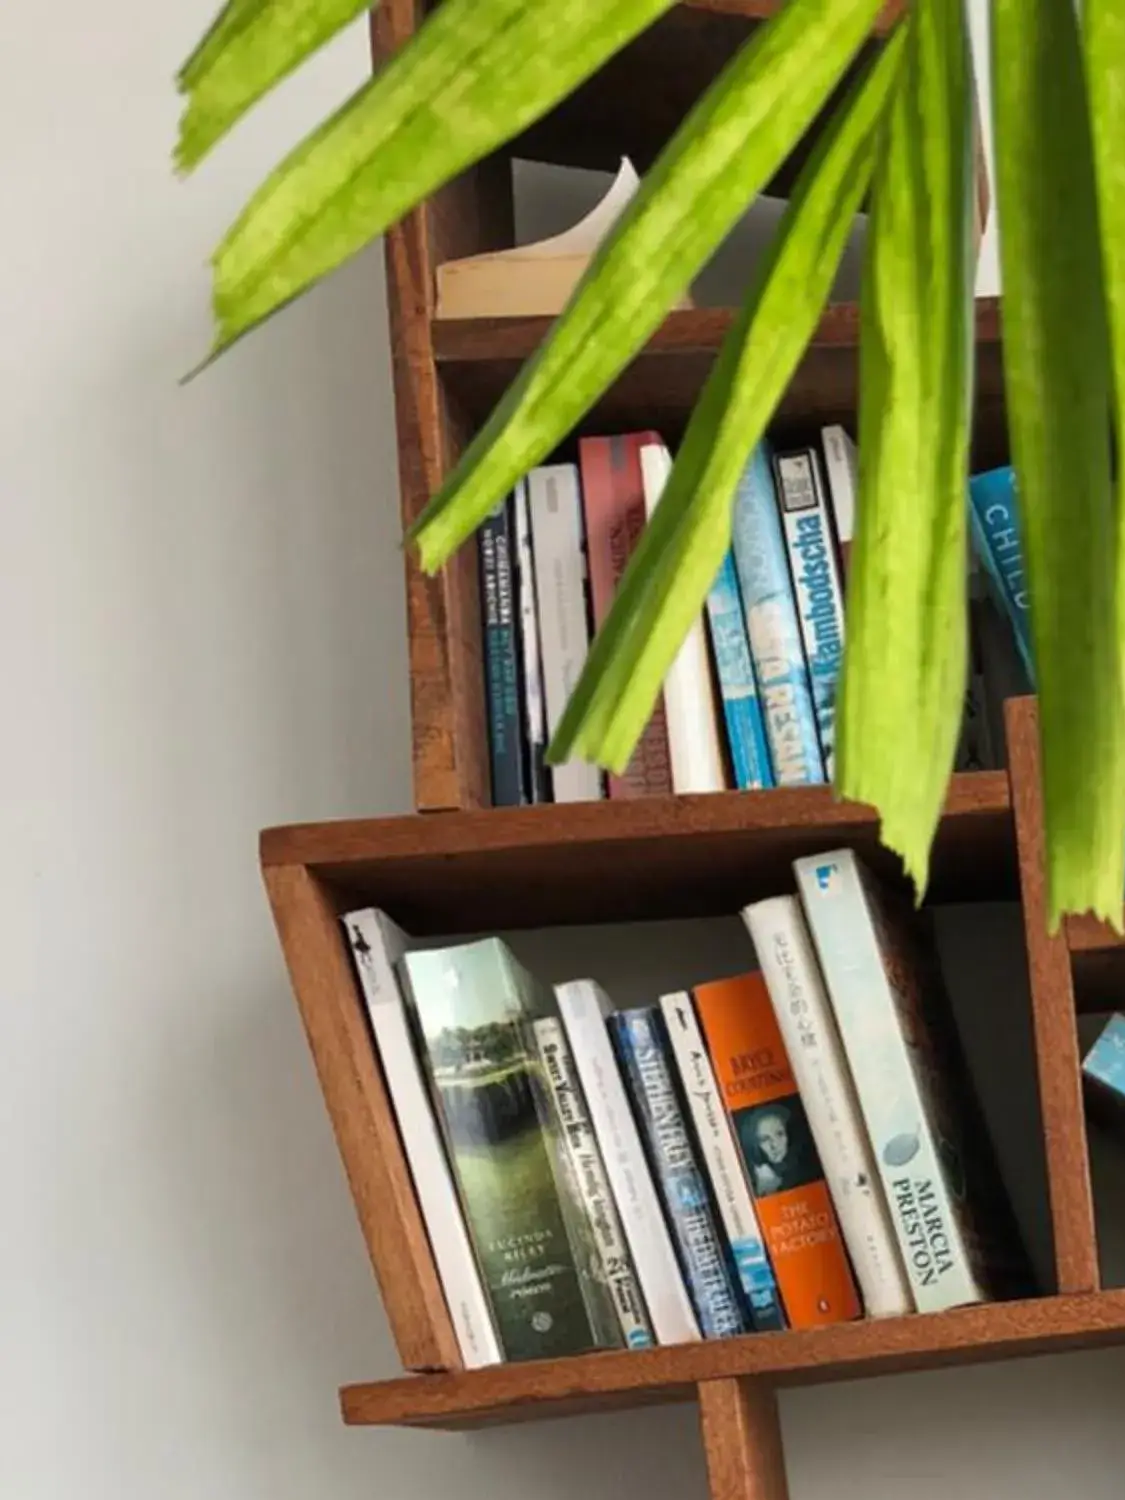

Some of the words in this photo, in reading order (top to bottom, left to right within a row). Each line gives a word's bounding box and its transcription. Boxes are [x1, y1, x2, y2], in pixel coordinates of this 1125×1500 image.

[792, 517, 840, 672] Kambodscha
[893, 1177, 936, 1287] PRESTON
[914, 1179, 951, 1272] MARCIA
